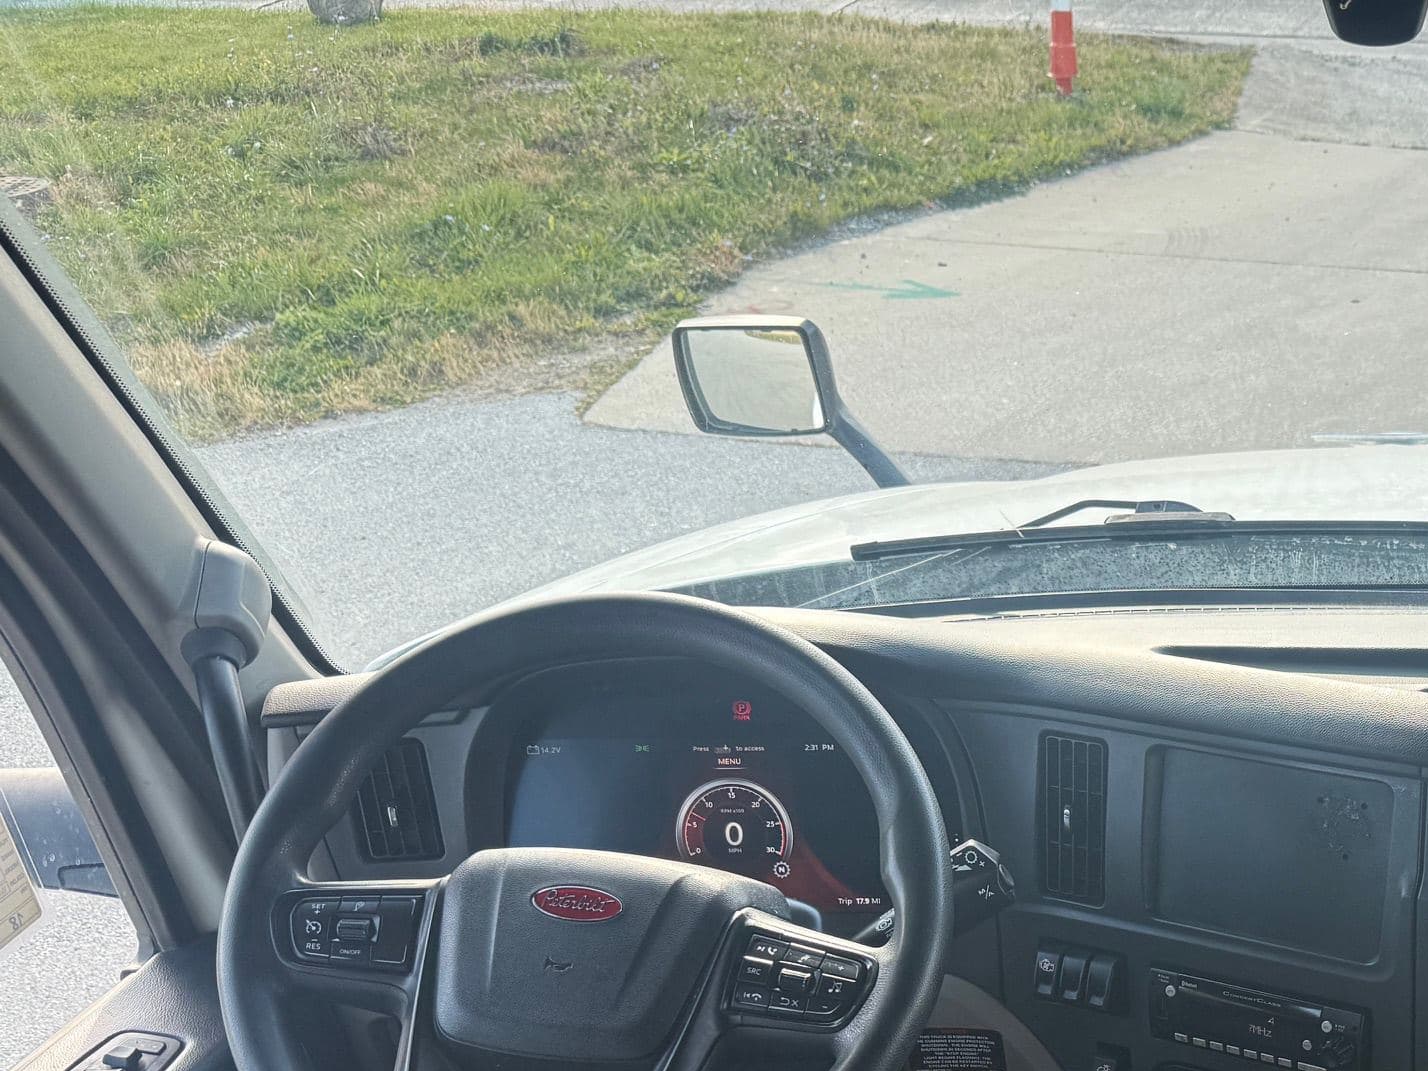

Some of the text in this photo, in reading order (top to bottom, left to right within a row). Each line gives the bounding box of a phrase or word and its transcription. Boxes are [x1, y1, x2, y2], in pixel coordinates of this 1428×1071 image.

[718, 758, 741, 766] MENU
[725, 821, 744, 846] 0
[838, 897, 853, 906] Trip
[746, 967, 762, 976] SRC
